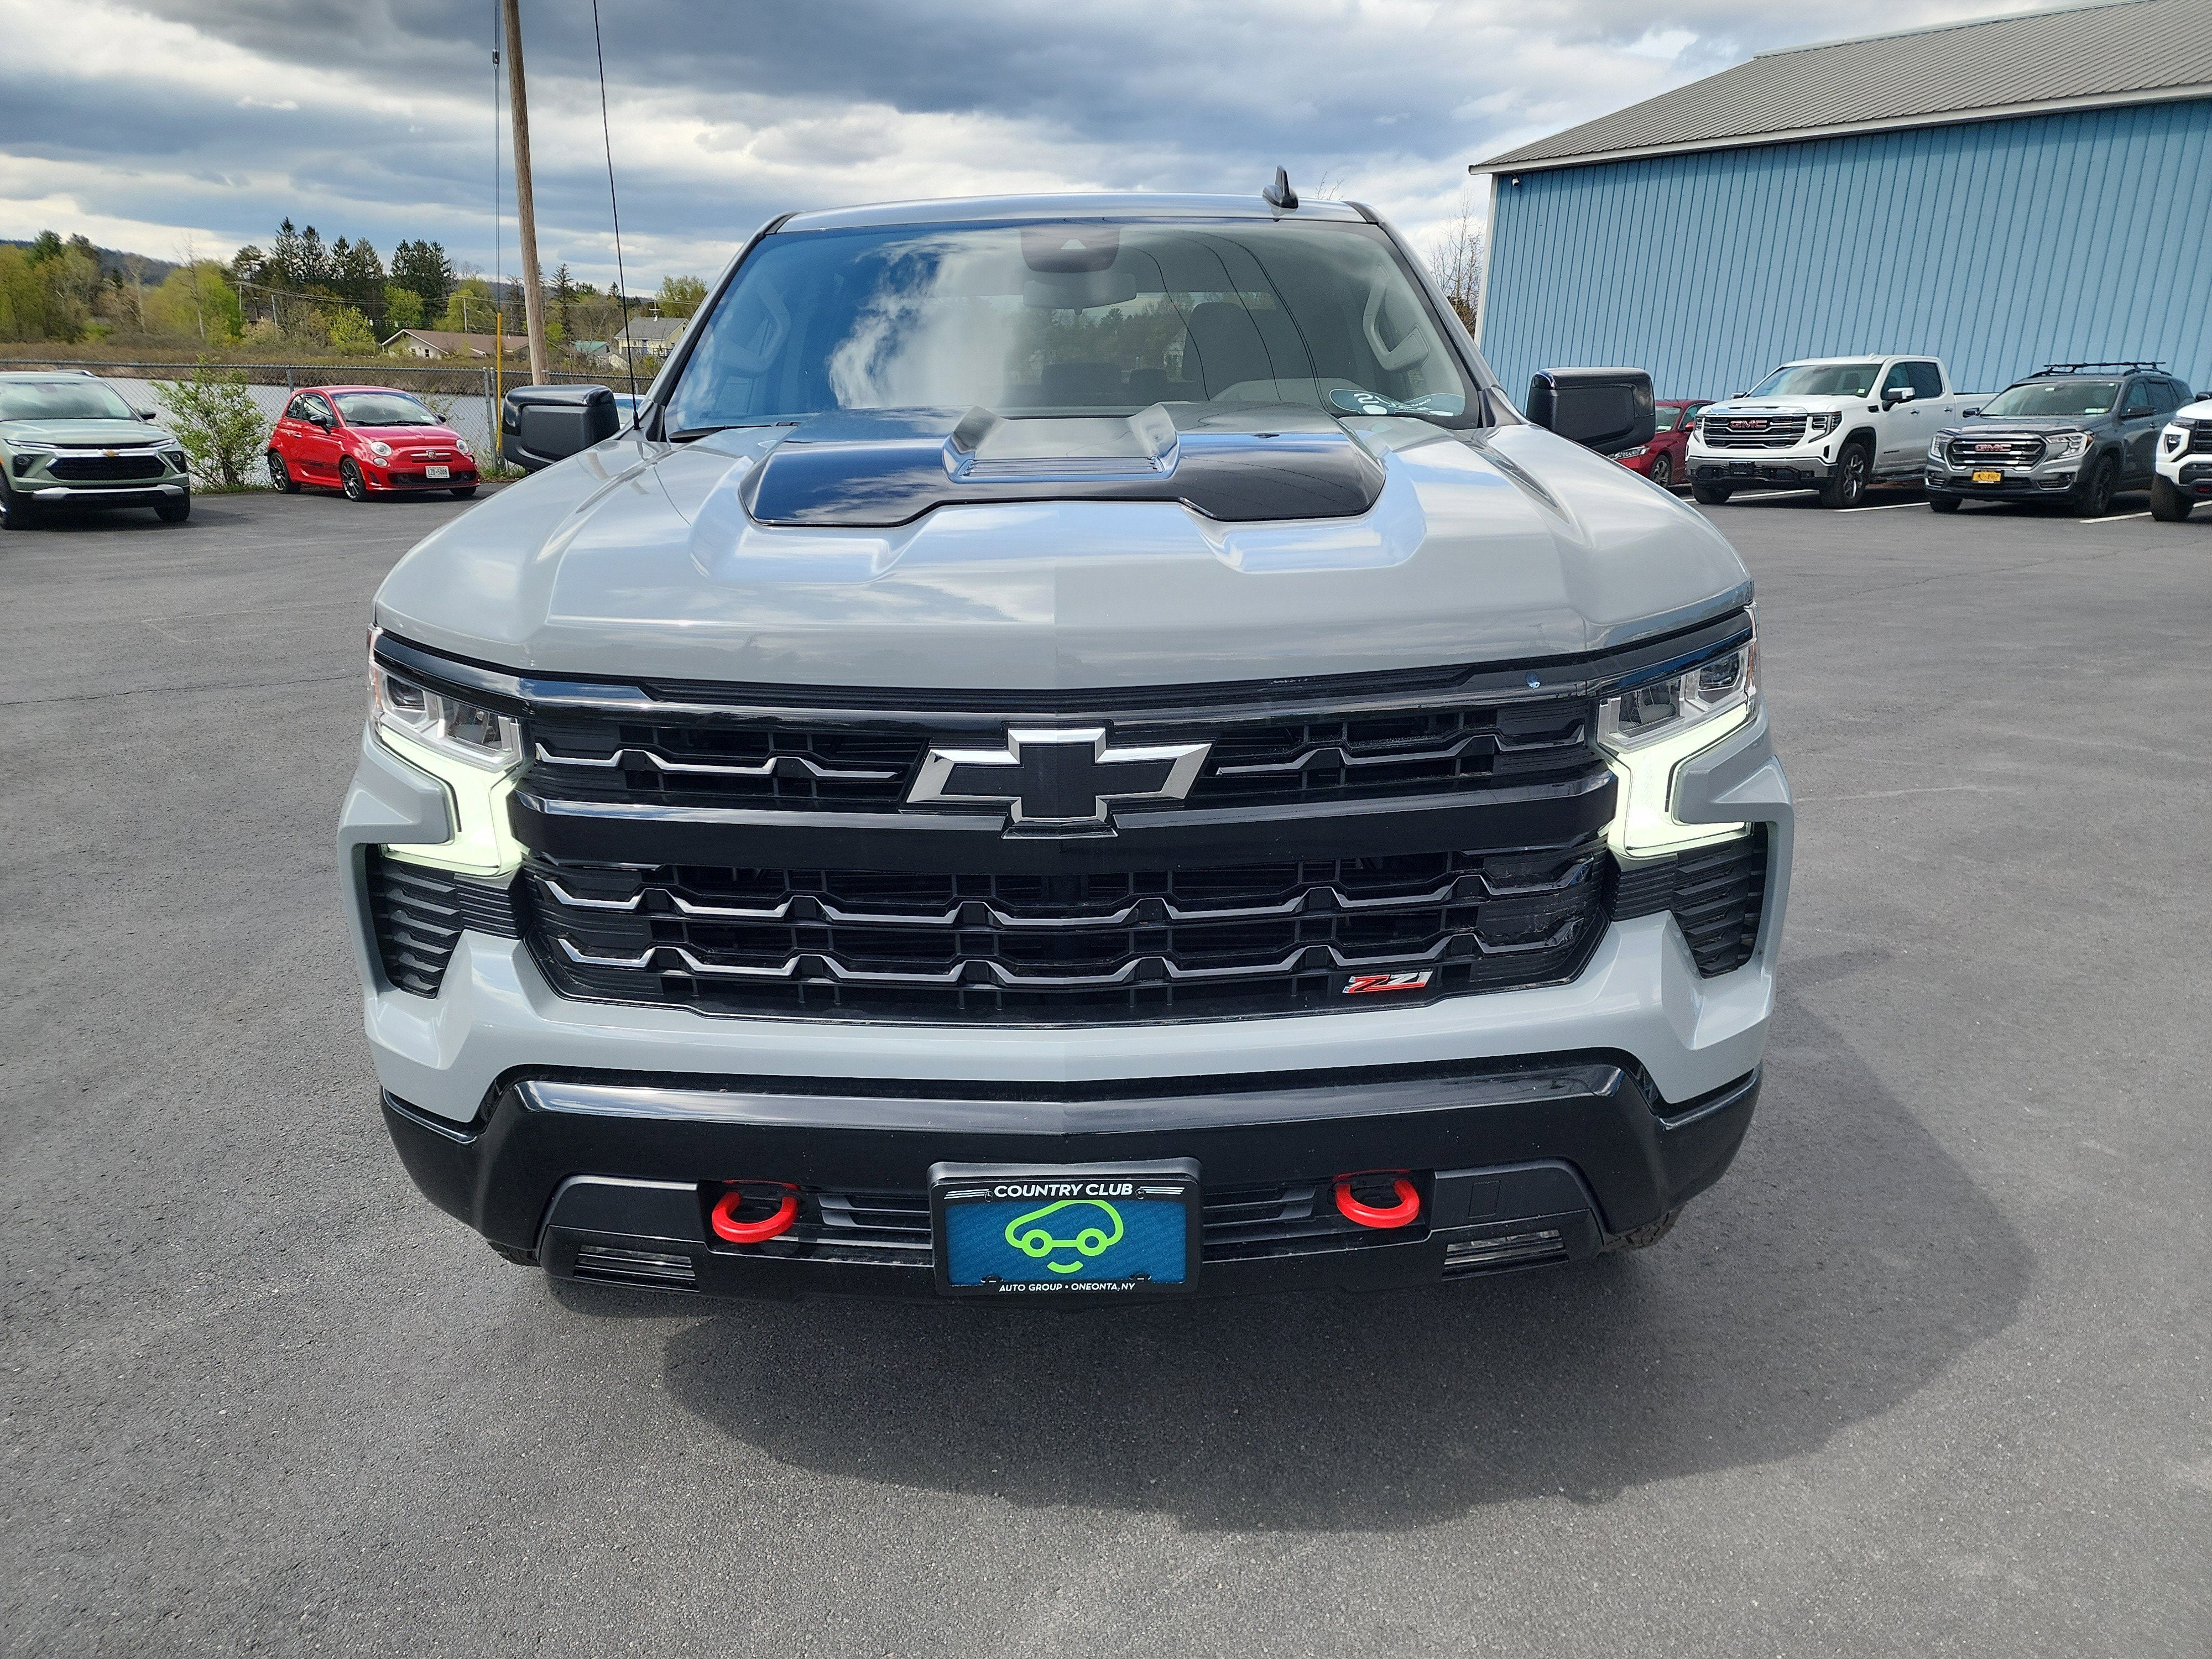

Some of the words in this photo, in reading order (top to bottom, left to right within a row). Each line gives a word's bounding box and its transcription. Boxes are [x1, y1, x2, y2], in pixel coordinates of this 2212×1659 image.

[1342, 971, 1433, 994] Z71
[994, 1184, 1084, 1197] COUNTRY
[1086, 1183, 1133, 1196] CLUB
[1029, 1283, 1063, 1291] GROUP
